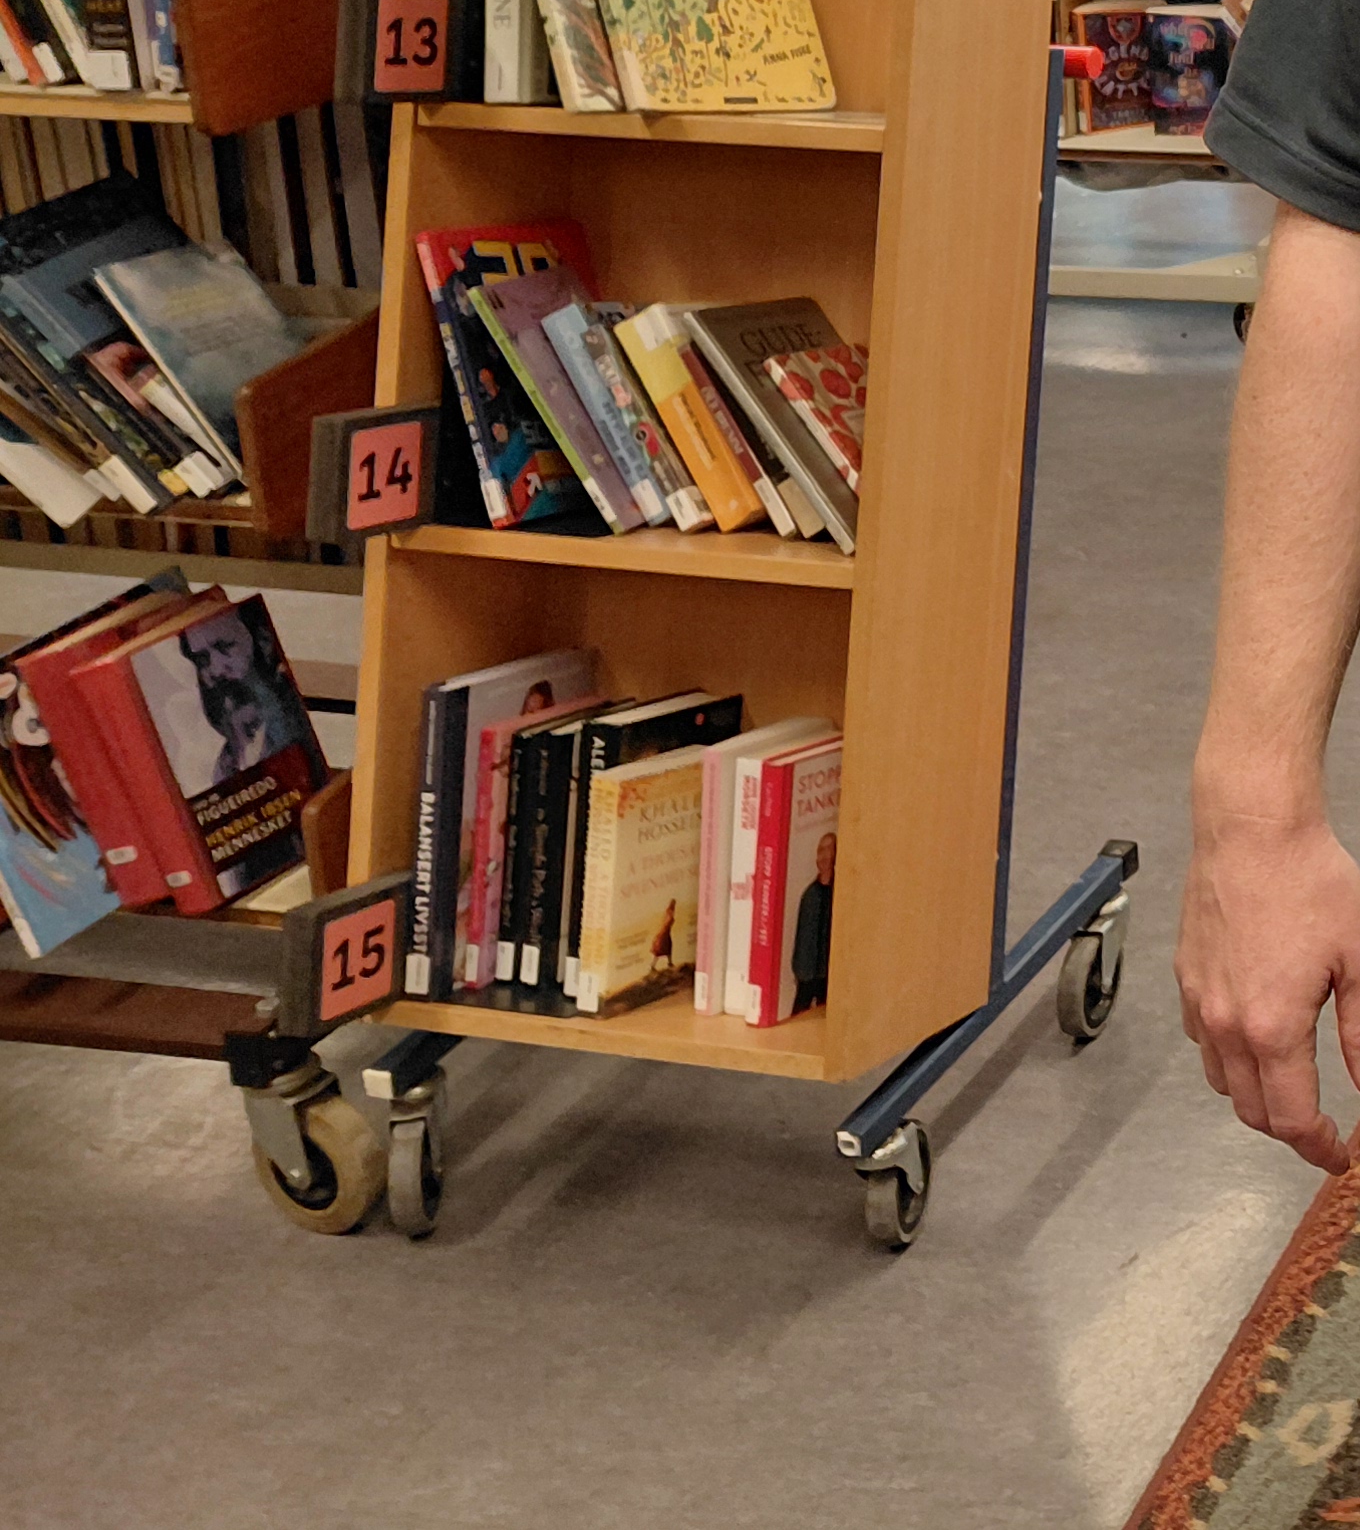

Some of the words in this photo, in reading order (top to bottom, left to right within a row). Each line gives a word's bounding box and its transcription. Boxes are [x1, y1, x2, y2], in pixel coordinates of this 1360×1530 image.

[384, 17, 439, 68] 13
[357, 446, 414, 503] 14
[796, 787, 842, 818] TANK
[415, 791, 436, 894] BALANSERT
[413, 895, 431, 954] LIVSST
[331, 923, 386, 992] 15
